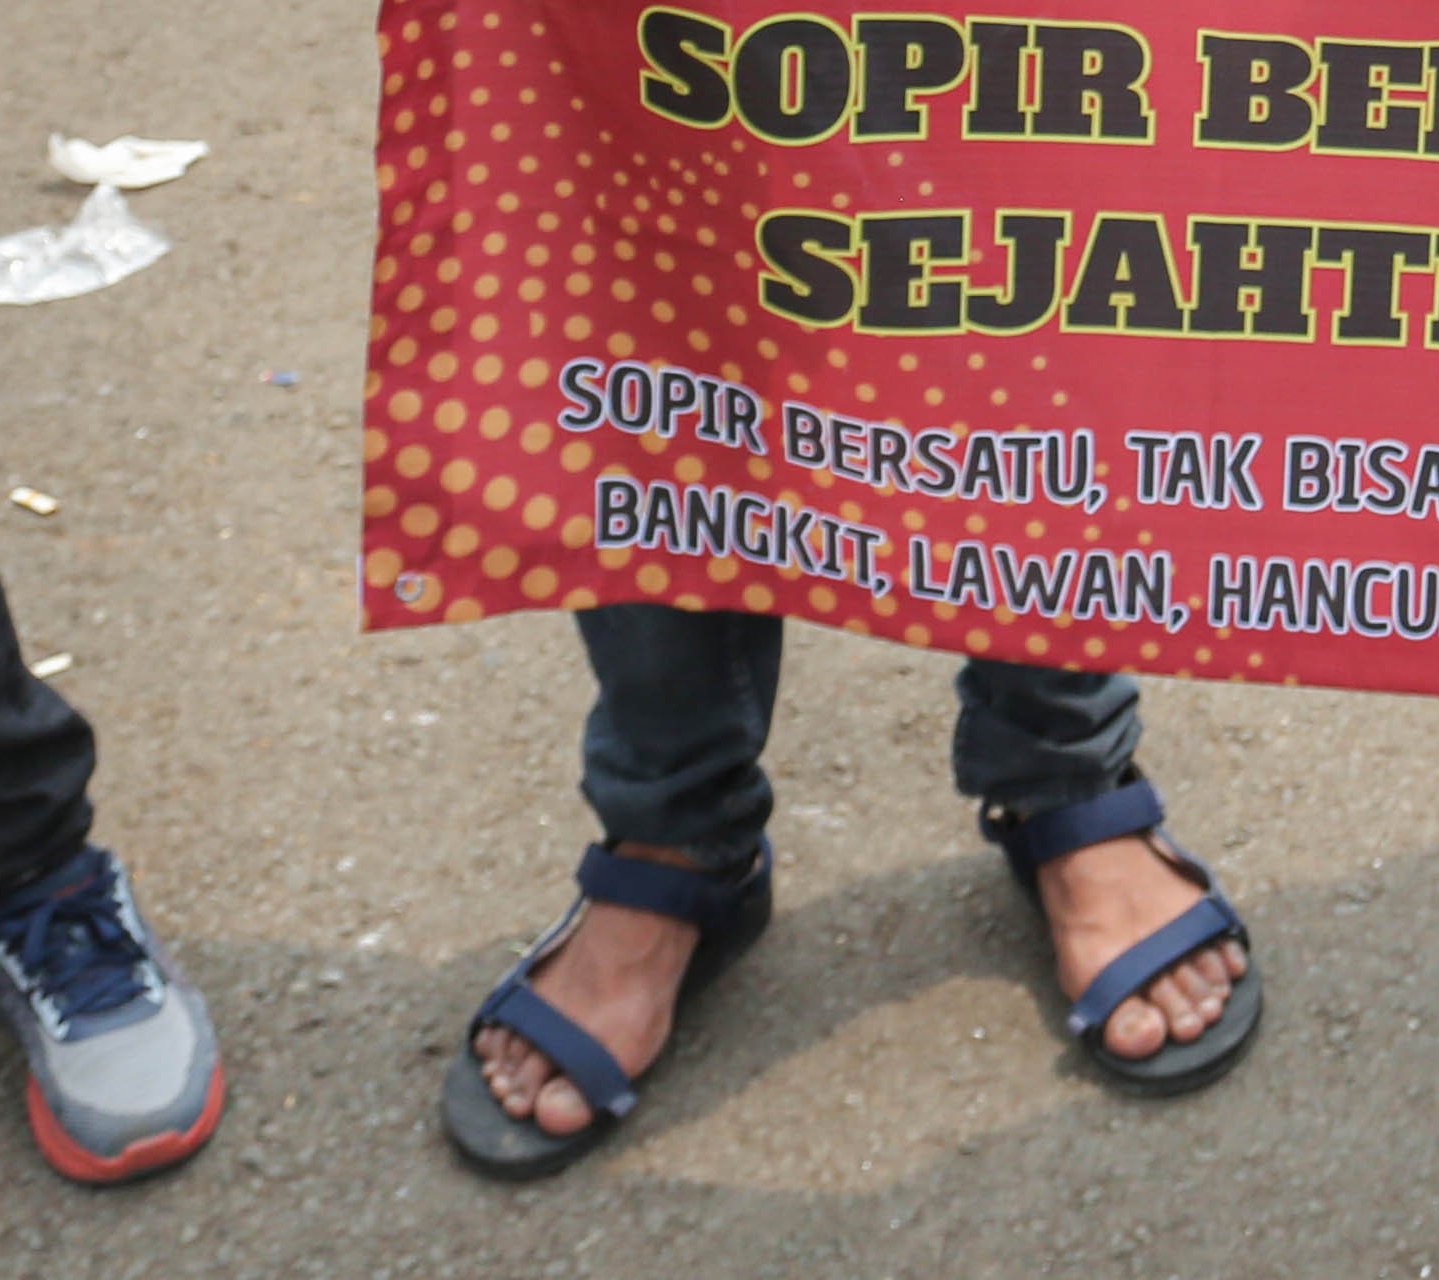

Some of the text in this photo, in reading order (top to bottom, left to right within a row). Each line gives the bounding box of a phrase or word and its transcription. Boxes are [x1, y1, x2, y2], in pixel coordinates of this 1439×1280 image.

[637, 4, 1156, 147] SOPIR
[557, 356, 769, 456] SOPIR
[780, 401, 1108, 514] BERSATU,
[1126, 430, 1267, 512] TAK
[594, 472, 893, 597] BANGKIT,
[907, 535, 1191, 633] LAWAN,
